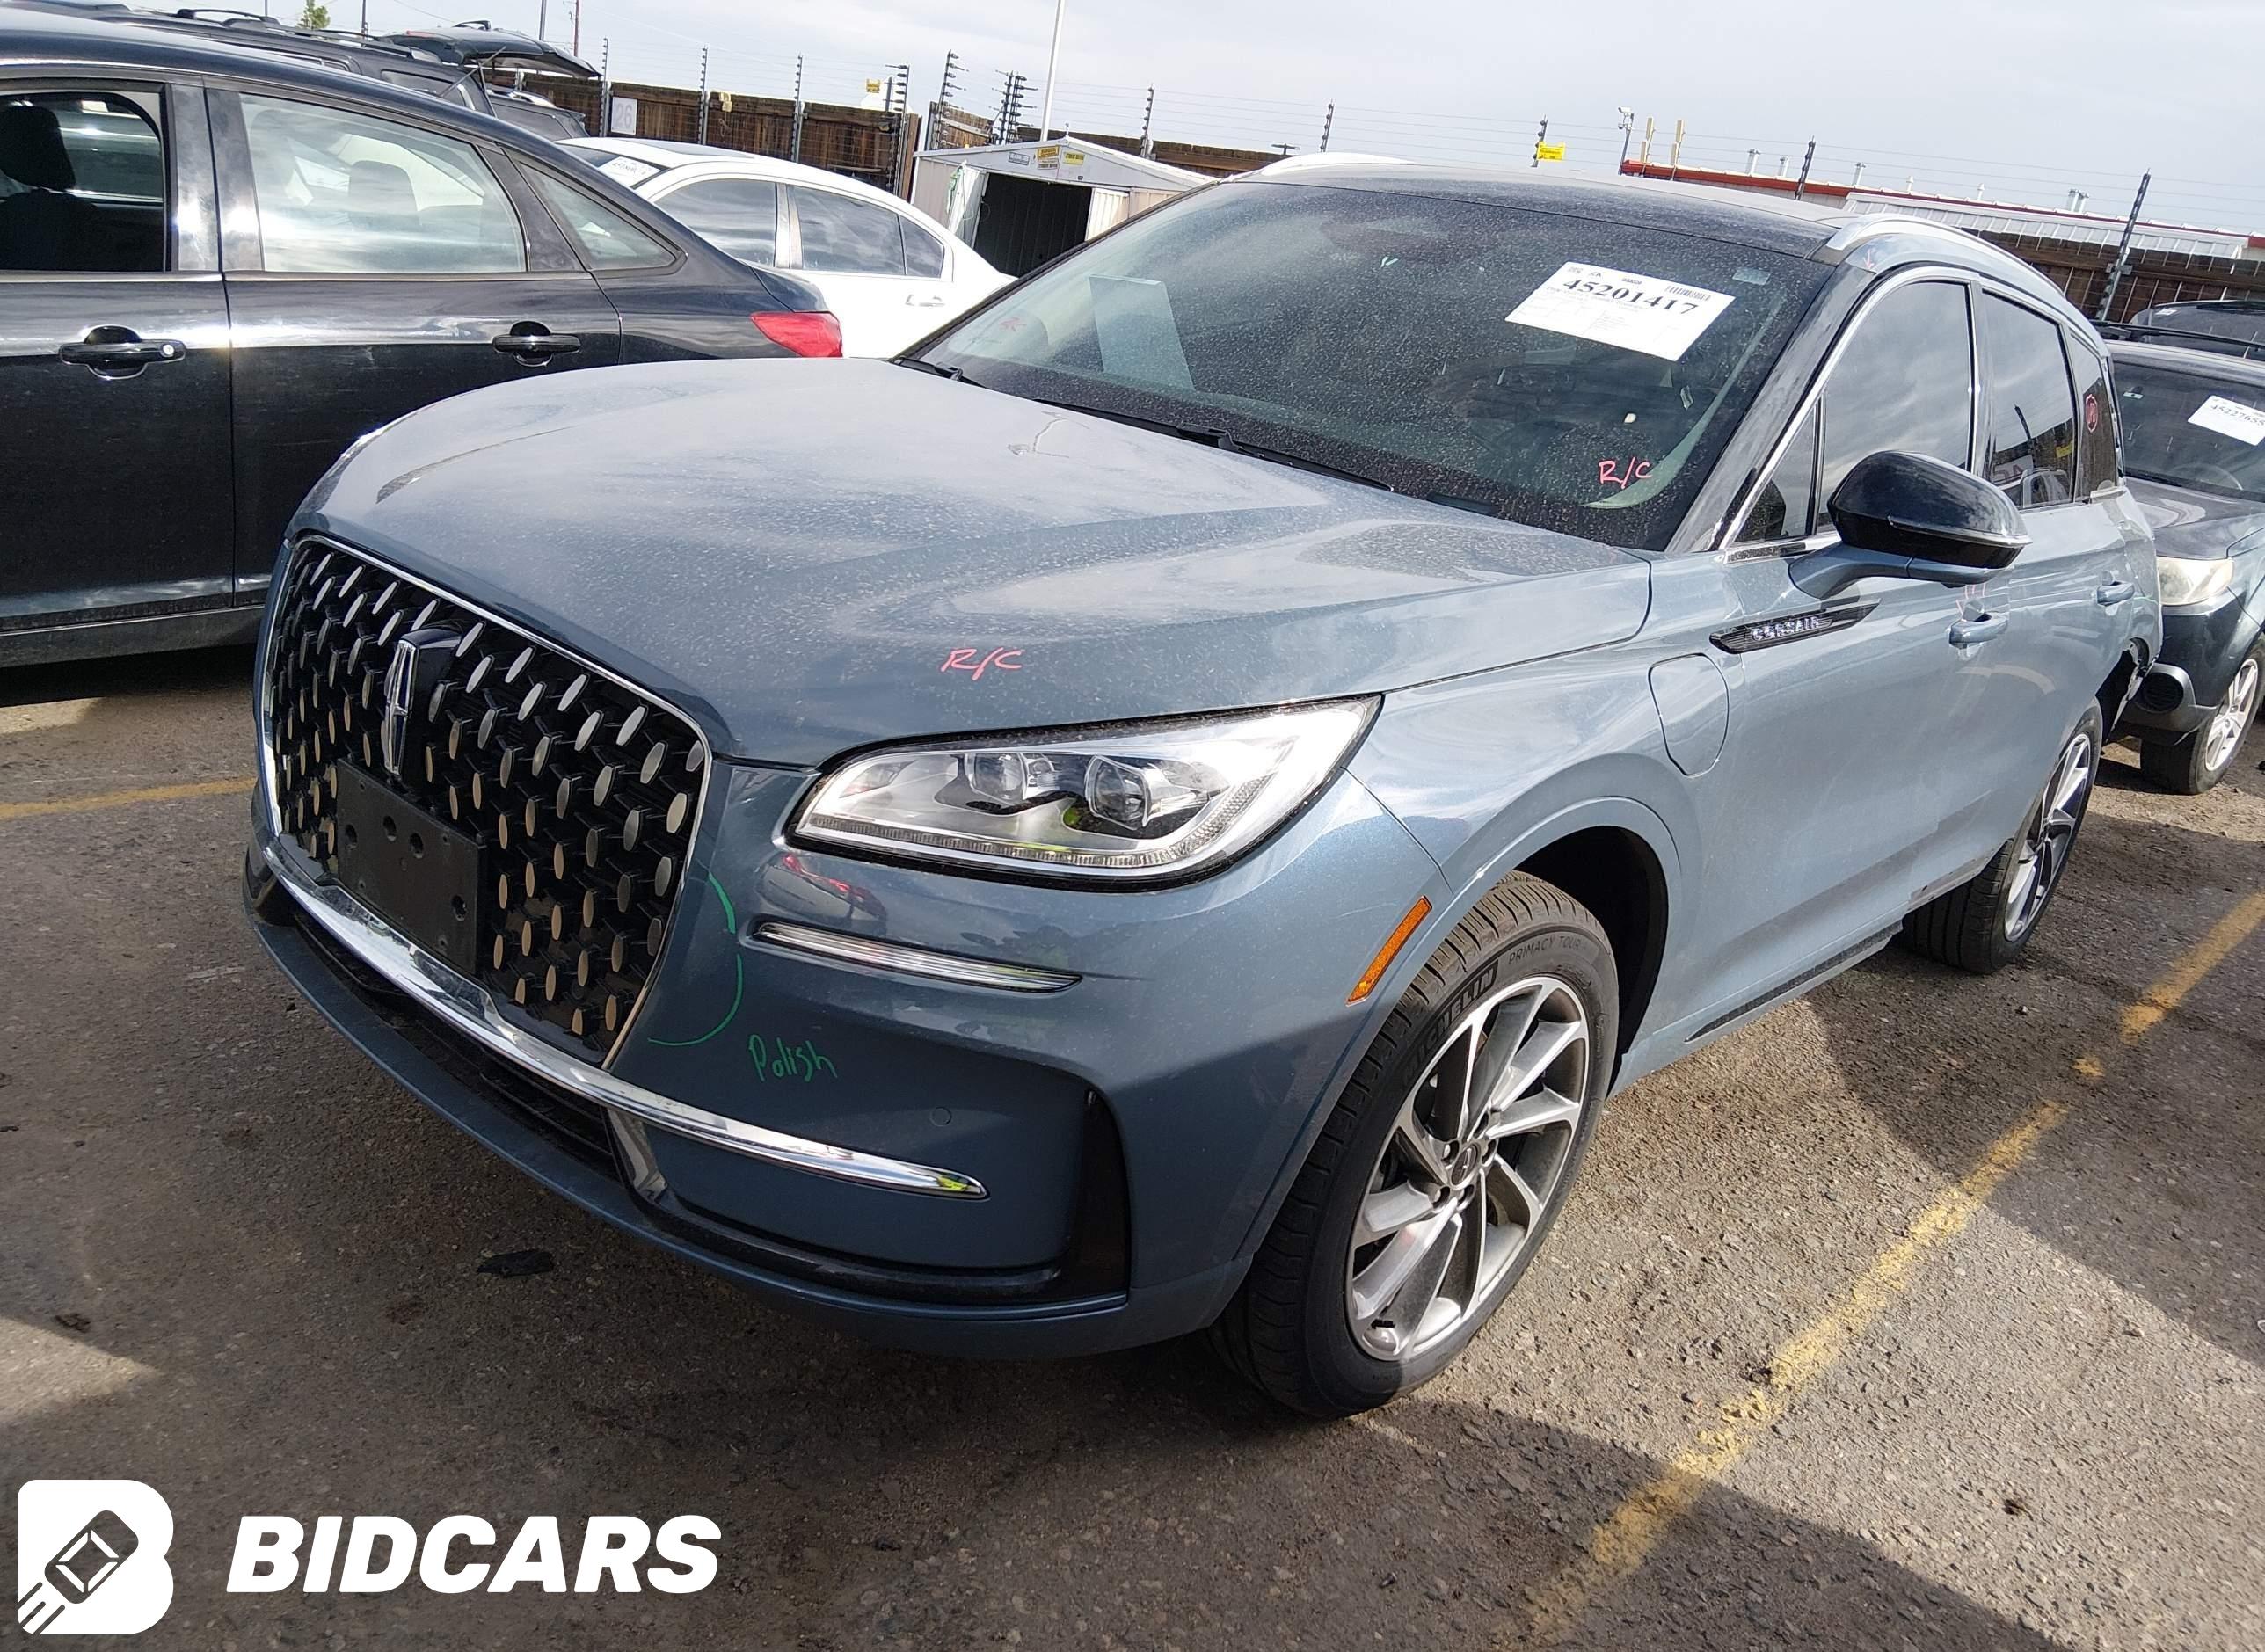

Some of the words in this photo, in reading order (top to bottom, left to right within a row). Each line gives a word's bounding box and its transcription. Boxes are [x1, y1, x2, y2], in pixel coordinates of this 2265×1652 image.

[1562, 278, 1699, 315] 45201417
[1599, 456, 1652, 489] R/C
[941, 647, 1024, 680] R/C
[1508, 936, 1555, 964] PRIMACY
[1559, 935, 1582, 950] TOUR
